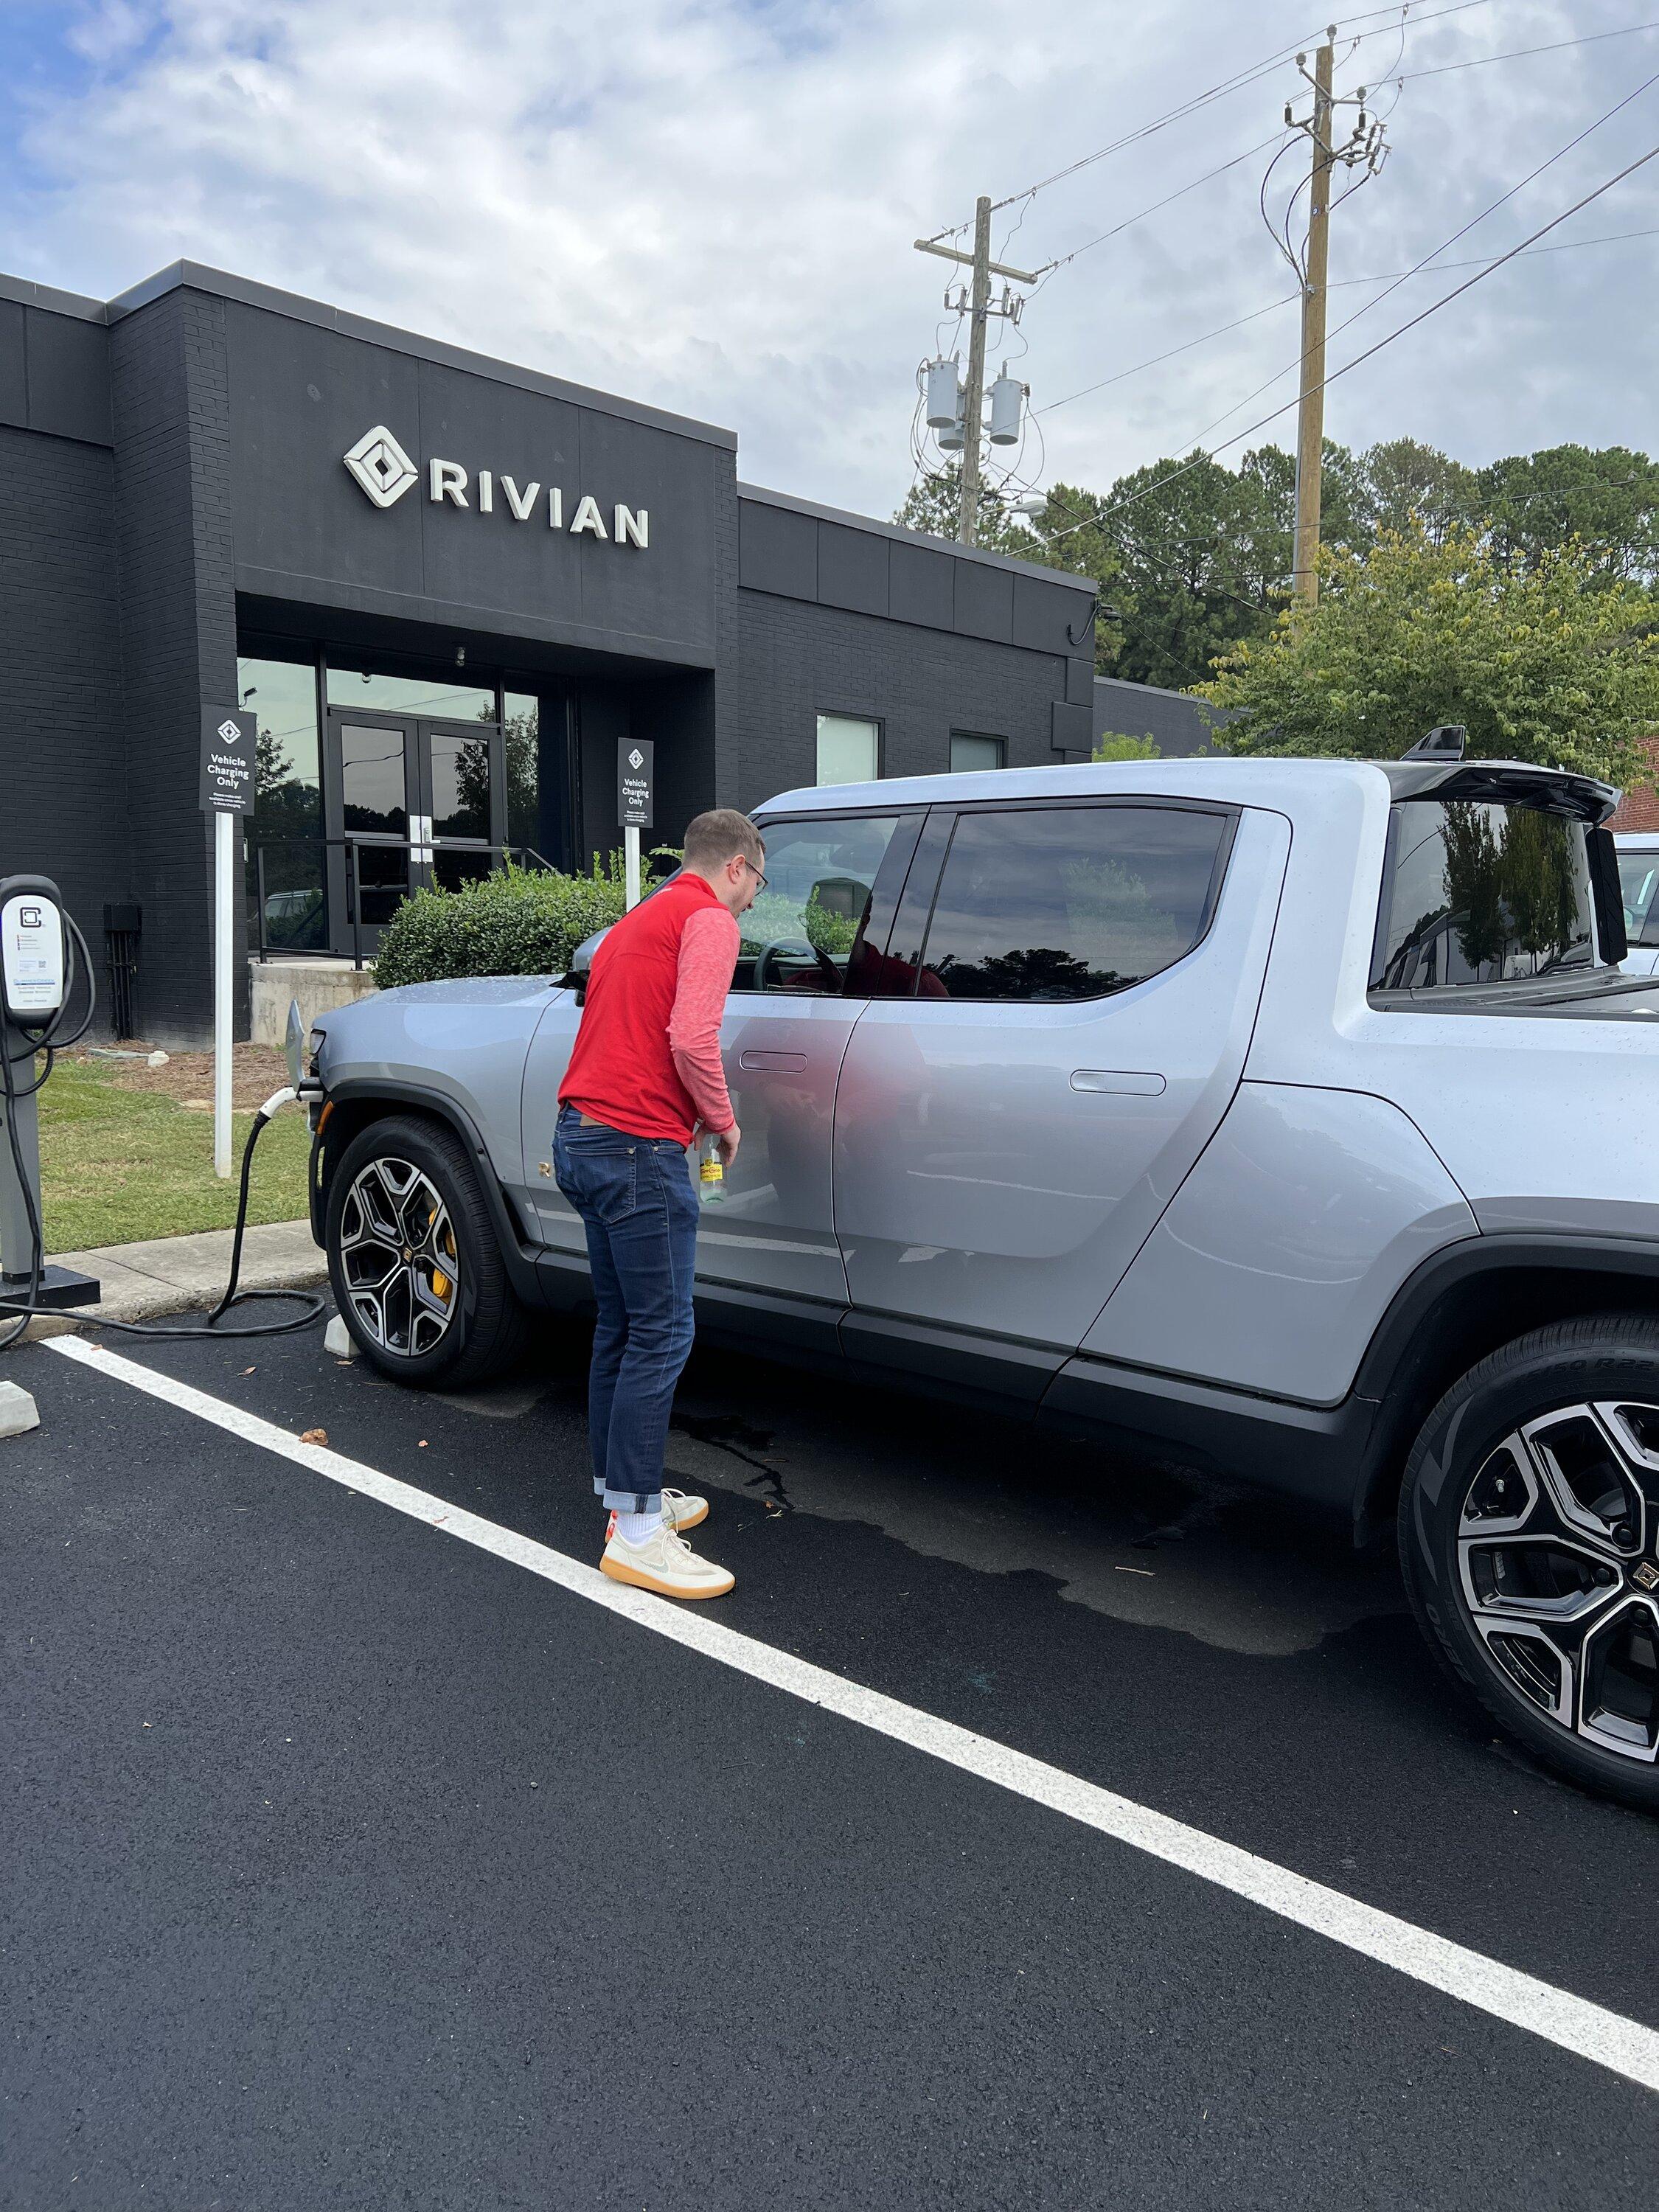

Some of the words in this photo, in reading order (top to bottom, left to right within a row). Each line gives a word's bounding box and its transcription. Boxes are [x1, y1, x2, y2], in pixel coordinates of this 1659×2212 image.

[429, 458, 649, 549] RIVIAN
[210, 754, 246, 767] Vehicle
[207, 764, 249, 780] Charging
[216, 776, 240, 790] Only
[624, 778, 647, 788] Vehicle
[622, 787, 649, 799] Charging
[628, 796, 643, 807] Only
